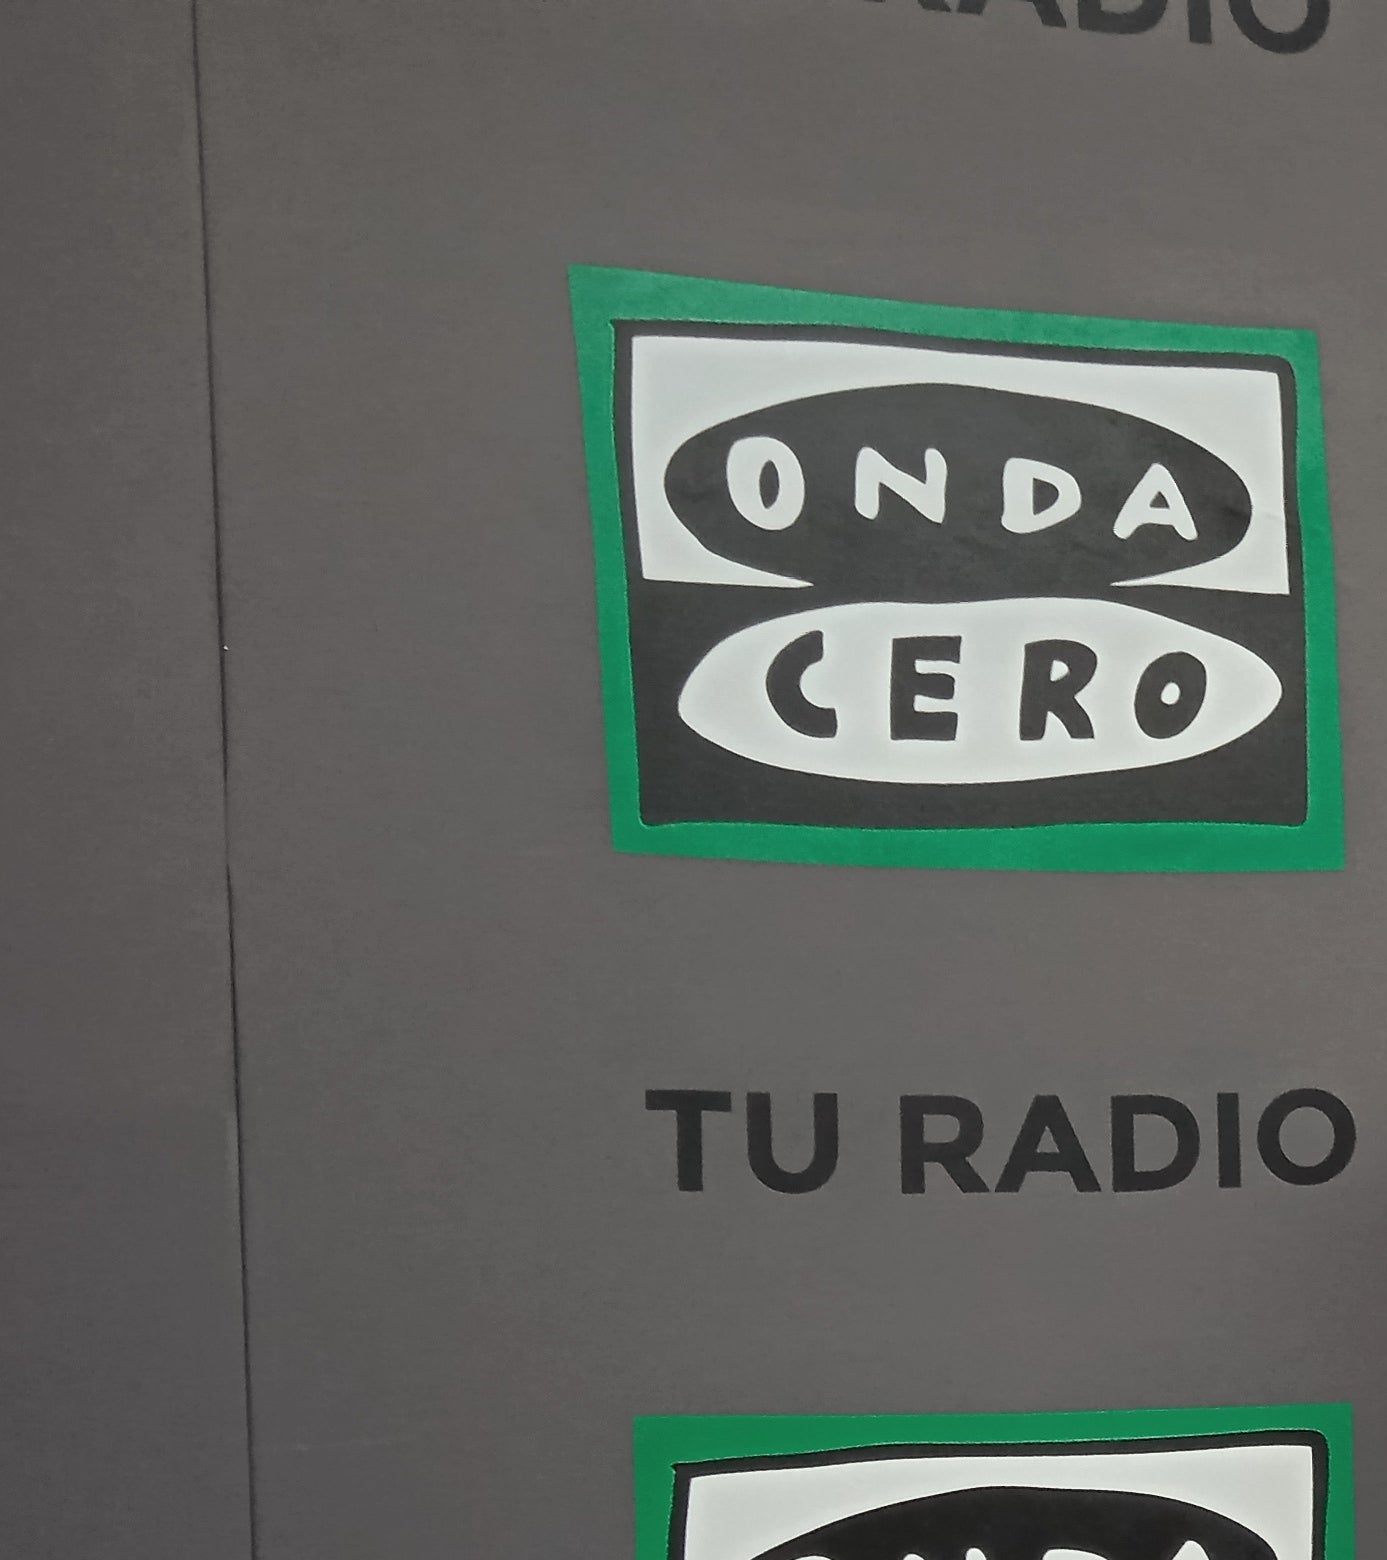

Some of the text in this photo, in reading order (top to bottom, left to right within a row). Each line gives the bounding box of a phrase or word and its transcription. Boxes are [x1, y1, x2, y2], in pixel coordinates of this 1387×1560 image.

[725, 435, 1198, 541] ONDA
[765, 630, 1207, 742] CERO
[645, 1088, 1357, 1195] TU RADIO
